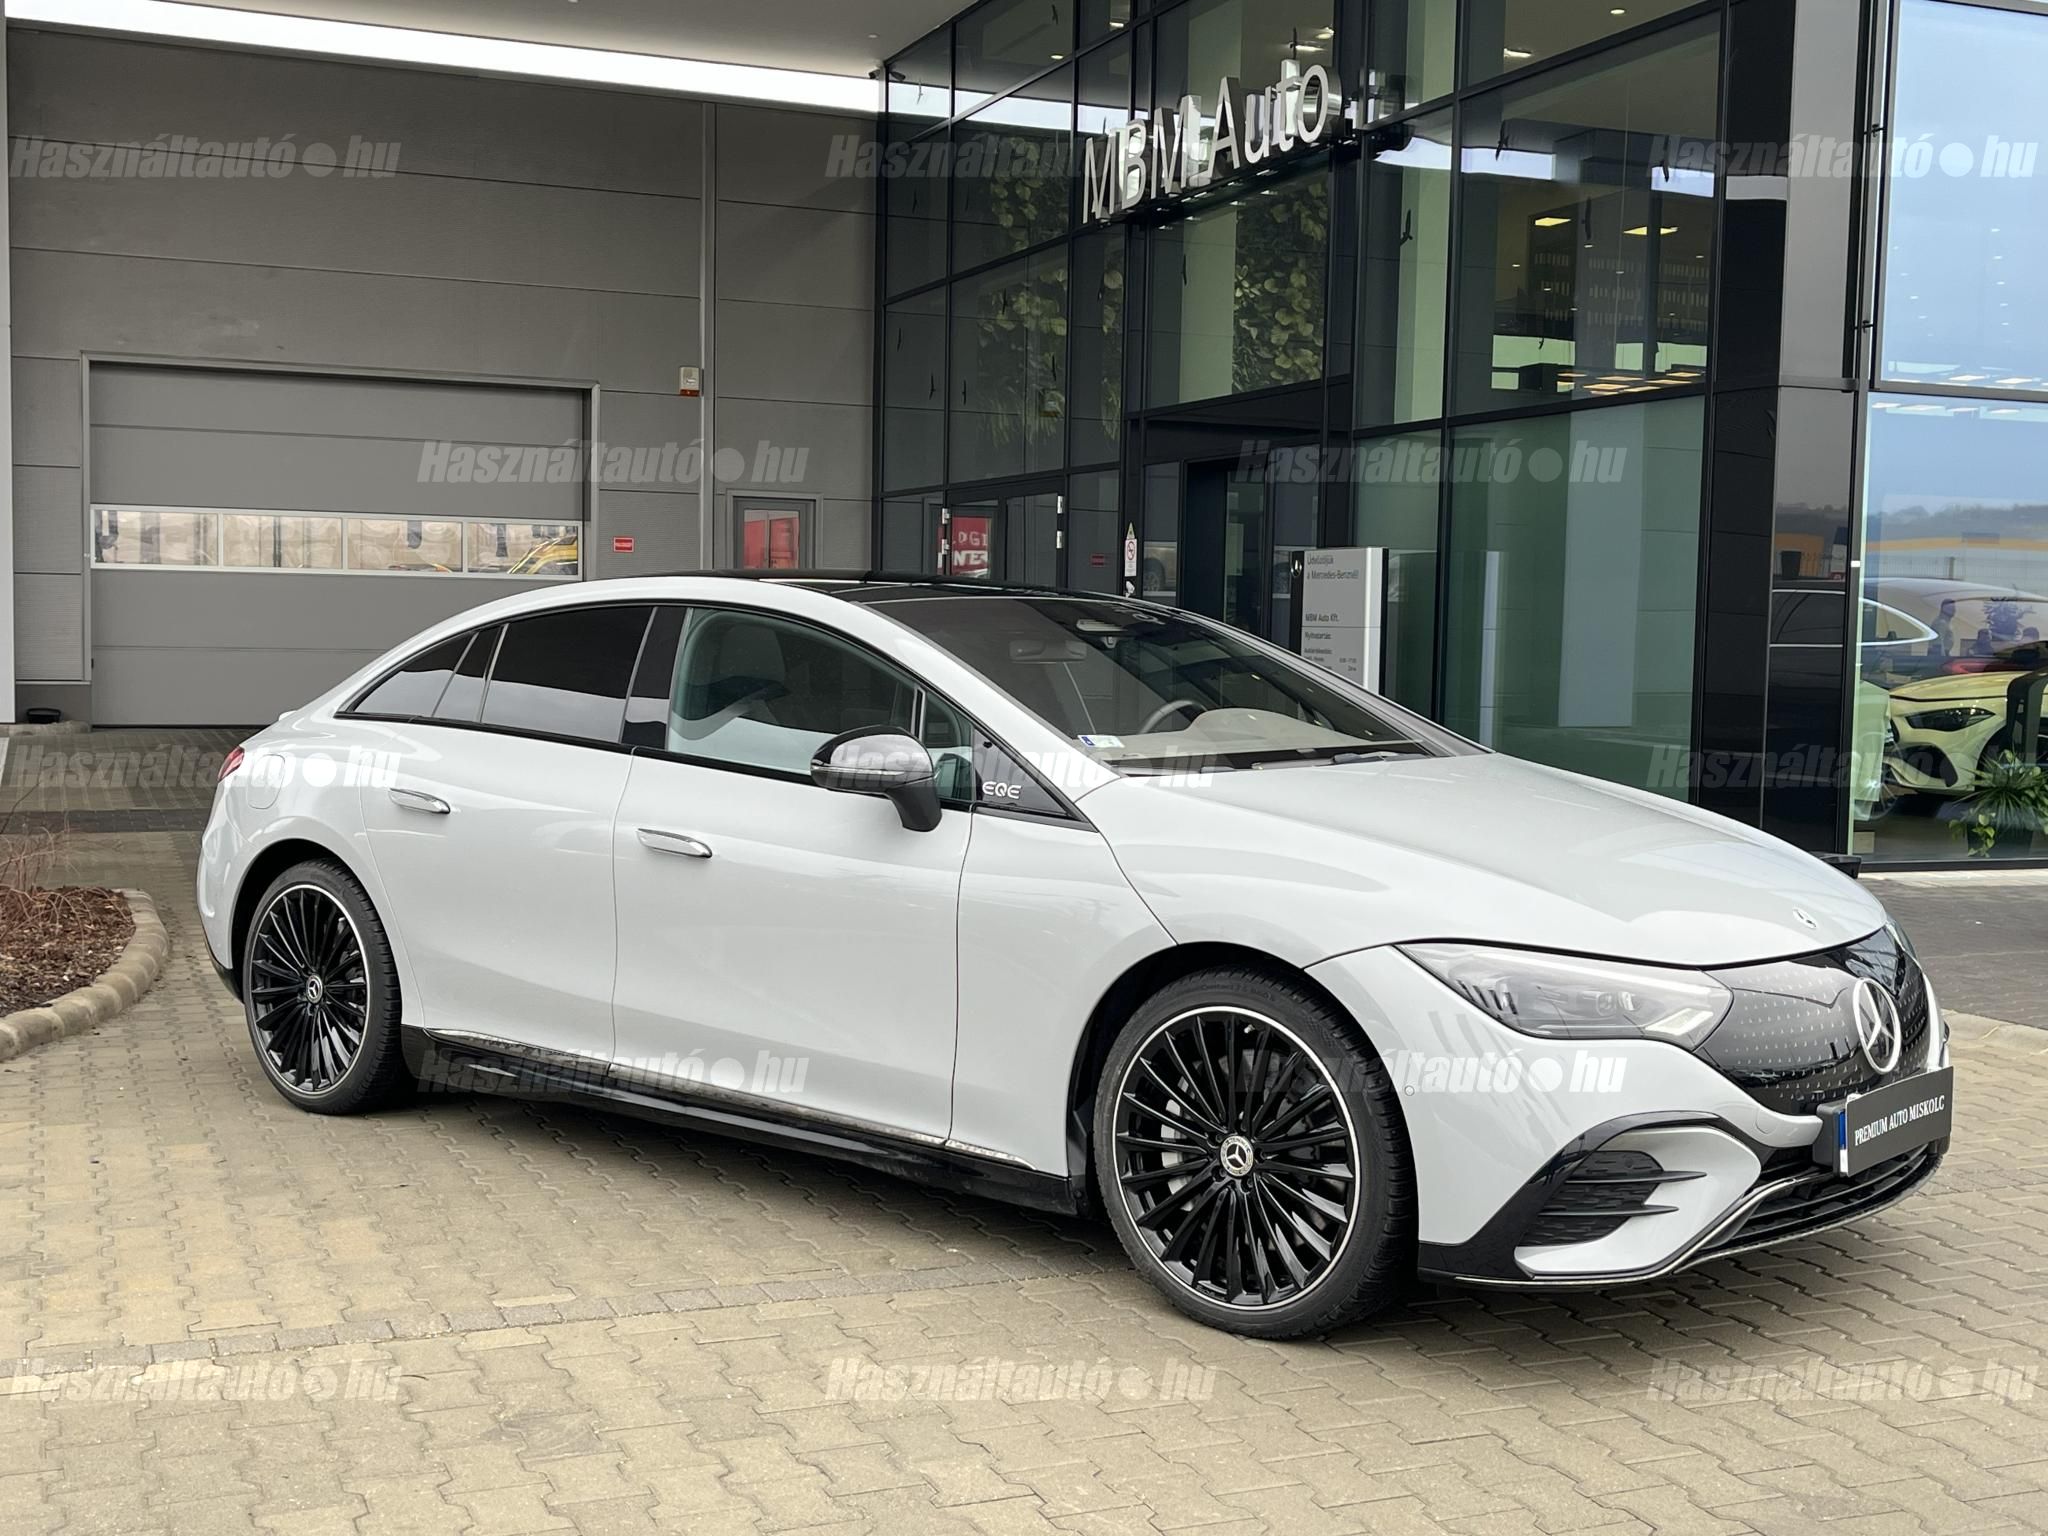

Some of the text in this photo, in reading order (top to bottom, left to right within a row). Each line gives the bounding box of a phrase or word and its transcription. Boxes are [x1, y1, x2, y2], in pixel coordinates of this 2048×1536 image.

[1082, 59, 1332, 224] MBM Auto
[981, 780, 1021, 799] EQE
[1854, 1095, 1945, 1146] PREMIUM AUTO MISKOLC
